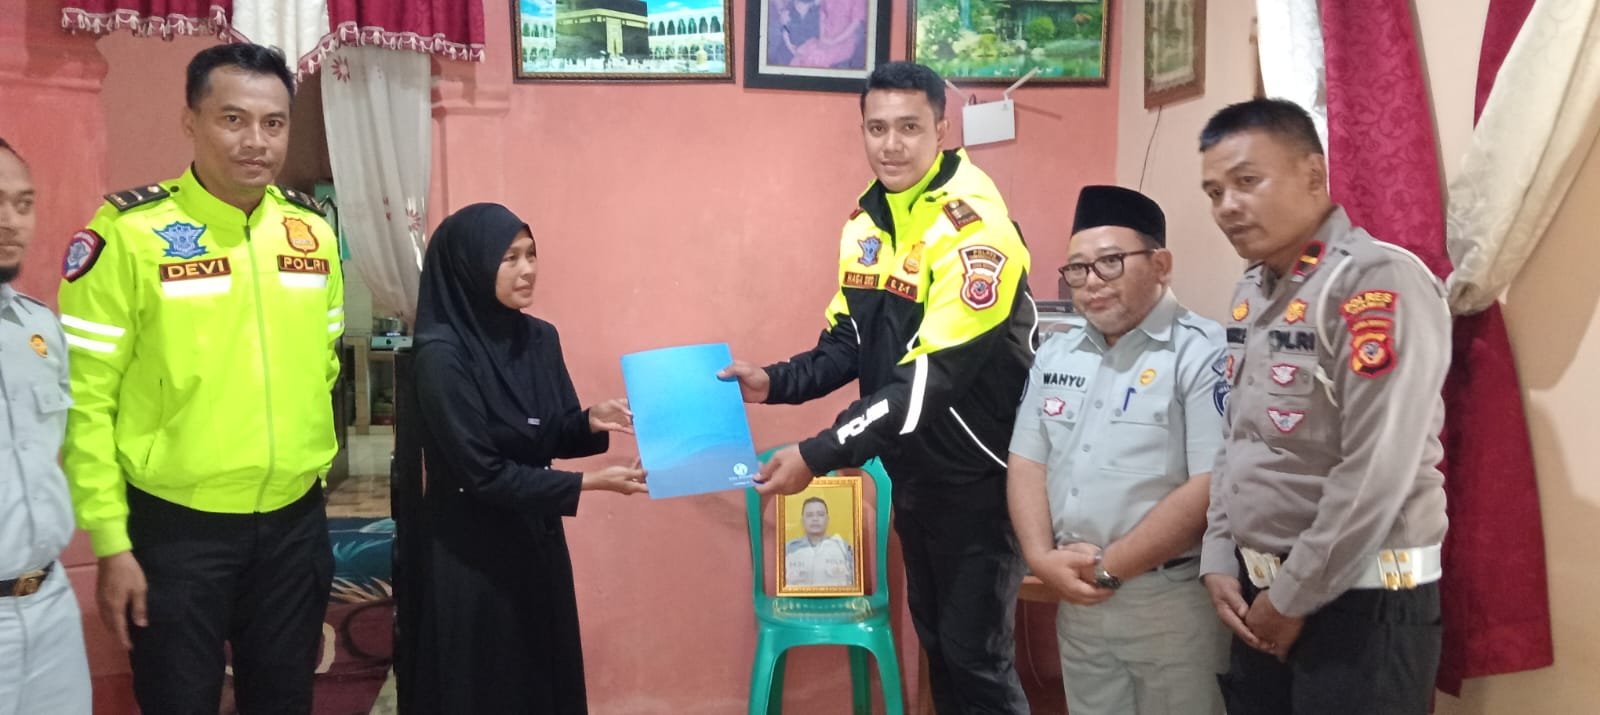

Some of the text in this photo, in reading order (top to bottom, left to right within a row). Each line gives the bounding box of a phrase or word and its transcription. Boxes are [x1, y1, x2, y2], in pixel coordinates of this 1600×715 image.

[167, 260, 225, 279] DEVI
[283, 256, 325, 272] POLRI
[1043, 373, 1086, 388] WAHYU
